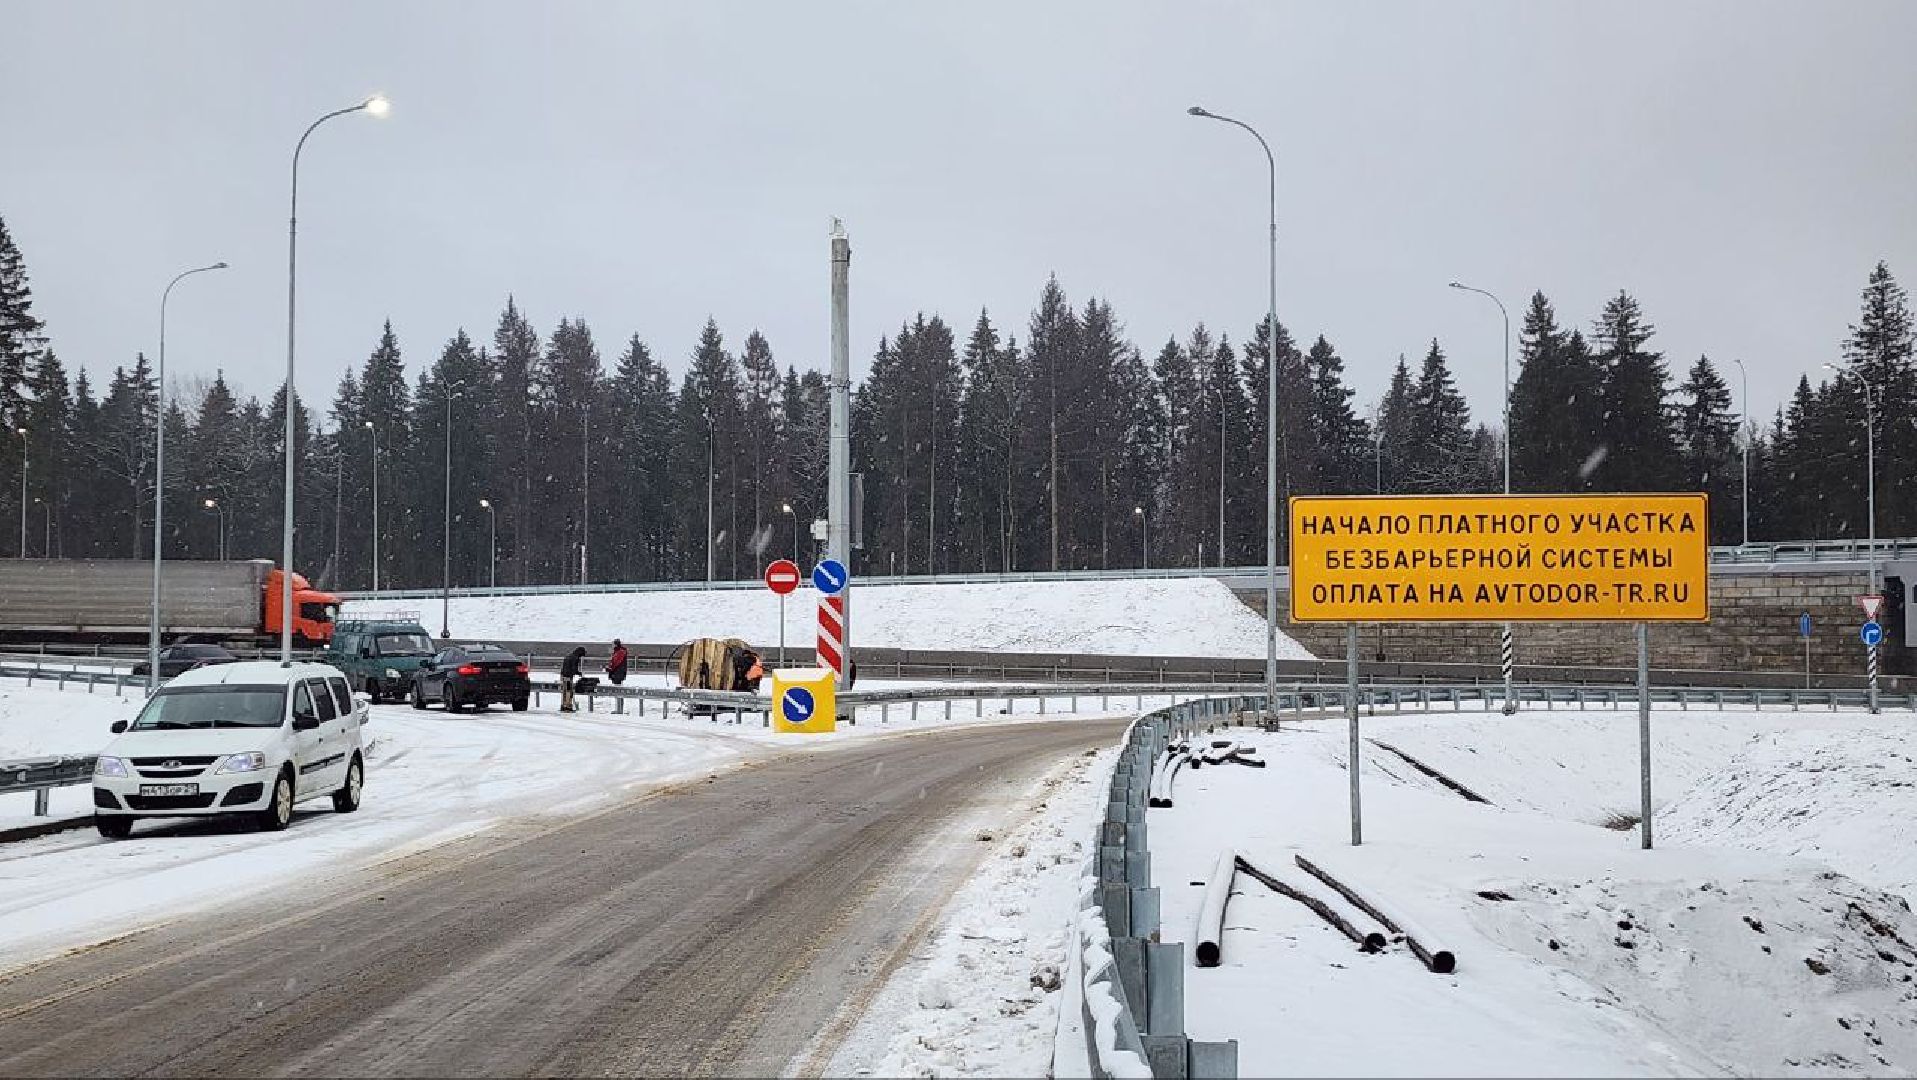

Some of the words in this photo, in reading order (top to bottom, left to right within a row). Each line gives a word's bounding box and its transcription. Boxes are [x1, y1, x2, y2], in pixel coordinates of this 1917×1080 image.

[1301, 513, 1410, 535] НАЧАЛО
[1418, 512, 1560, 534] ПЛАТНОГО
[1570, 512, 1696, 534] УЧАСТКА
[1325, 542, 1531, 570] БЕЗБАРЬЕРНОЙ
[1541, 547, 1672, 570] СИСТЕМЫ
[1312, 583, 1419, 604] ОПЛАТА
[1429, 583, 1464, 604] НА
[1474, 582, 1688, 604] AVTODOR-TR.RU
